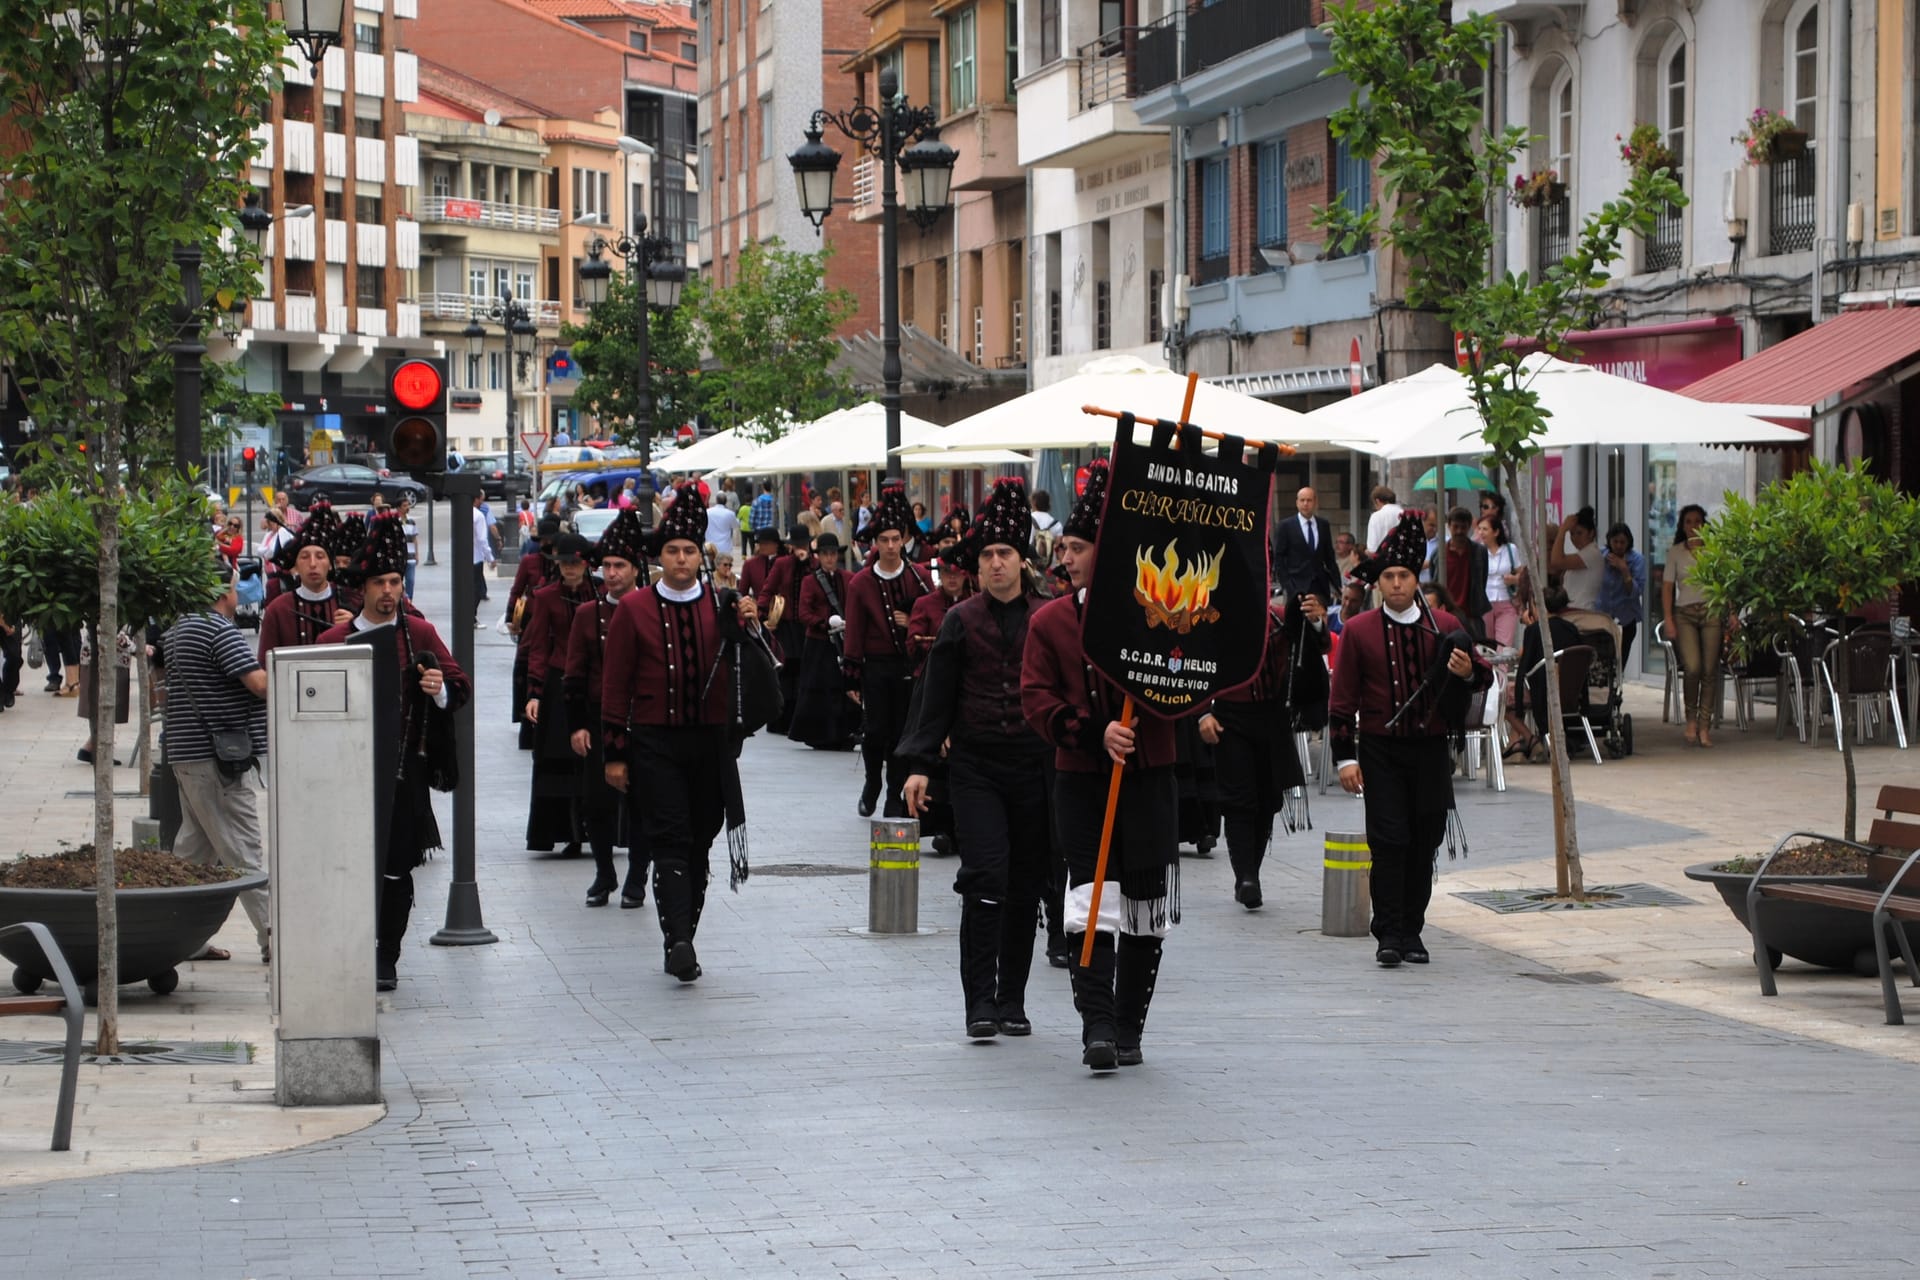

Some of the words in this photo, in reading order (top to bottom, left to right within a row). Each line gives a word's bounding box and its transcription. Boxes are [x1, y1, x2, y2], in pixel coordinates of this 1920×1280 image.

[1147, 462, 1181, 485] BANDA
[1195, 472, 1238, 495] GAITAS
[1120, 648, 1166, 667] S.C.D.R.
[1183, 658, 1217, 674] HELIOS
[1127, 670, 1209, 691] BEMBRIVE-VIGO
[1144, 688, 1192, 704] GALICIA
